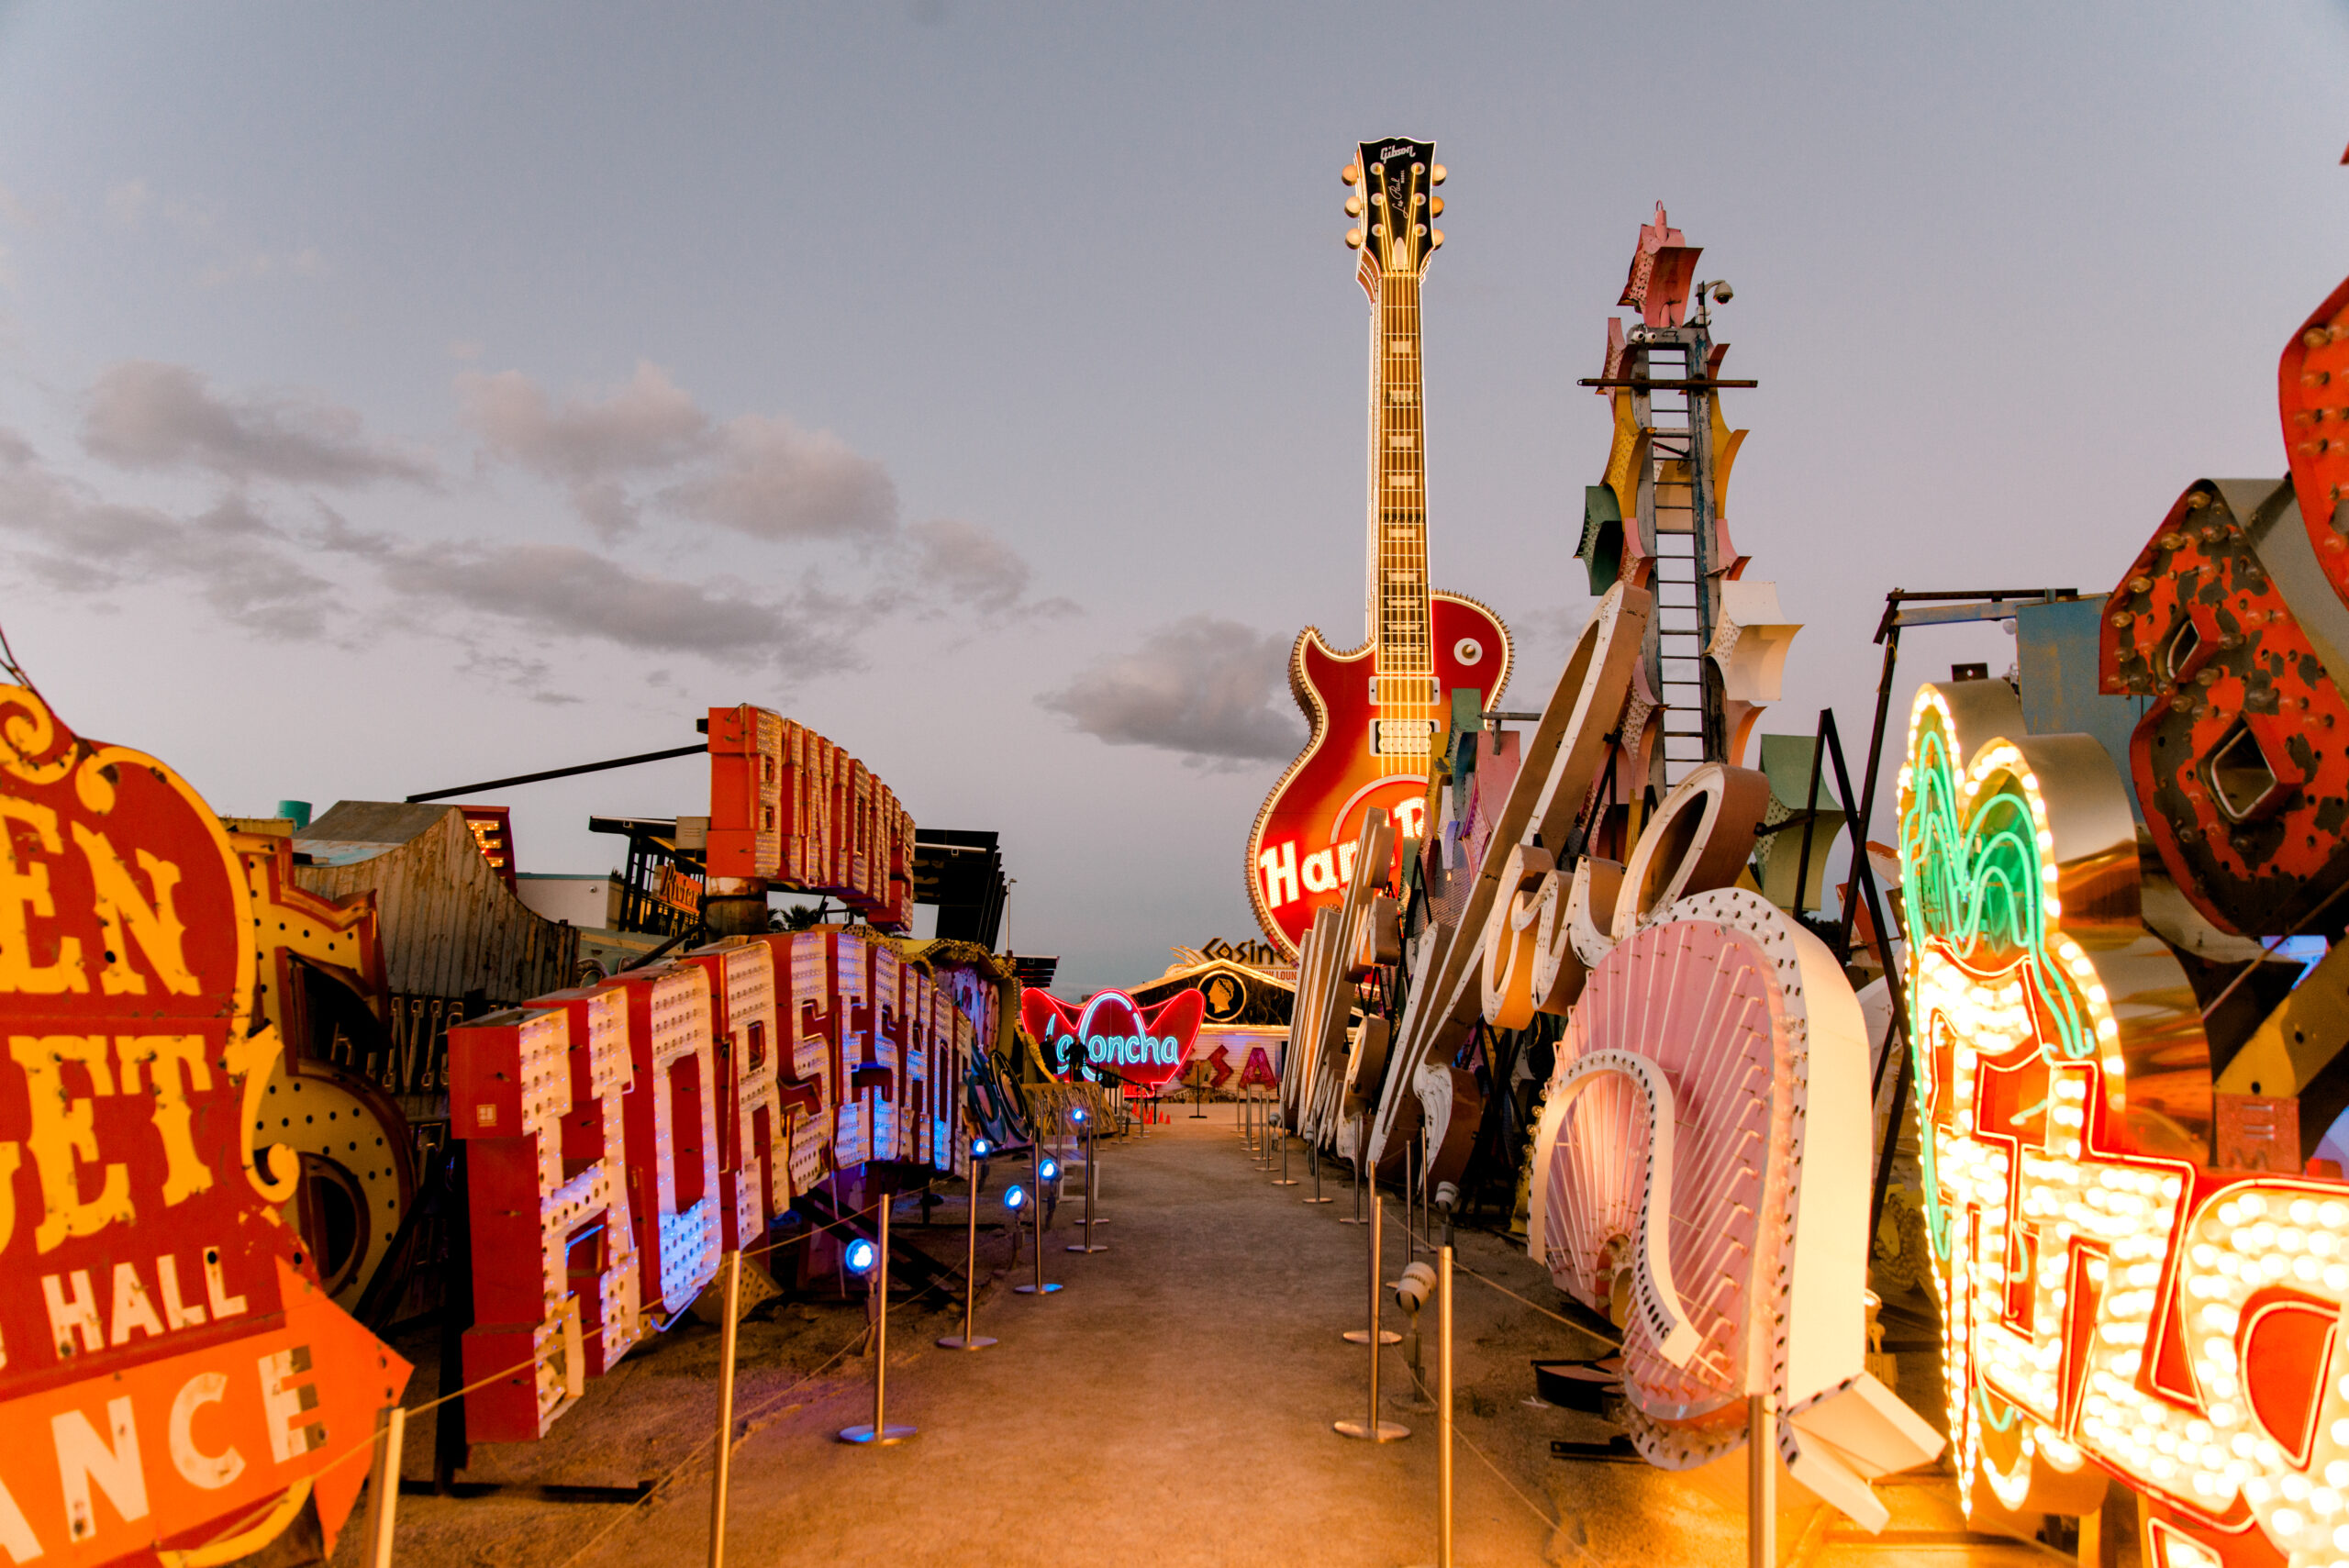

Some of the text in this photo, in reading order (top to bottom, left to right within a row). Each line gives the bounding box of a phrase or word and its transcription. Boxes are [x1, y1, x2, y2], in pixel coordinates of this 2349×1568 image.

[1380, 145, 1416, 164] Gibson
[1387, 177, 1403, 200] Paul
[1199, 937, 1288, 964] Casin
[1077, 992, 1180, 1083] Concha
[0, 1034, 213, 1254] ET
[495, 929, 973, 1439] HORSESHOE
[41, 1246, 248, 1361] HALL
